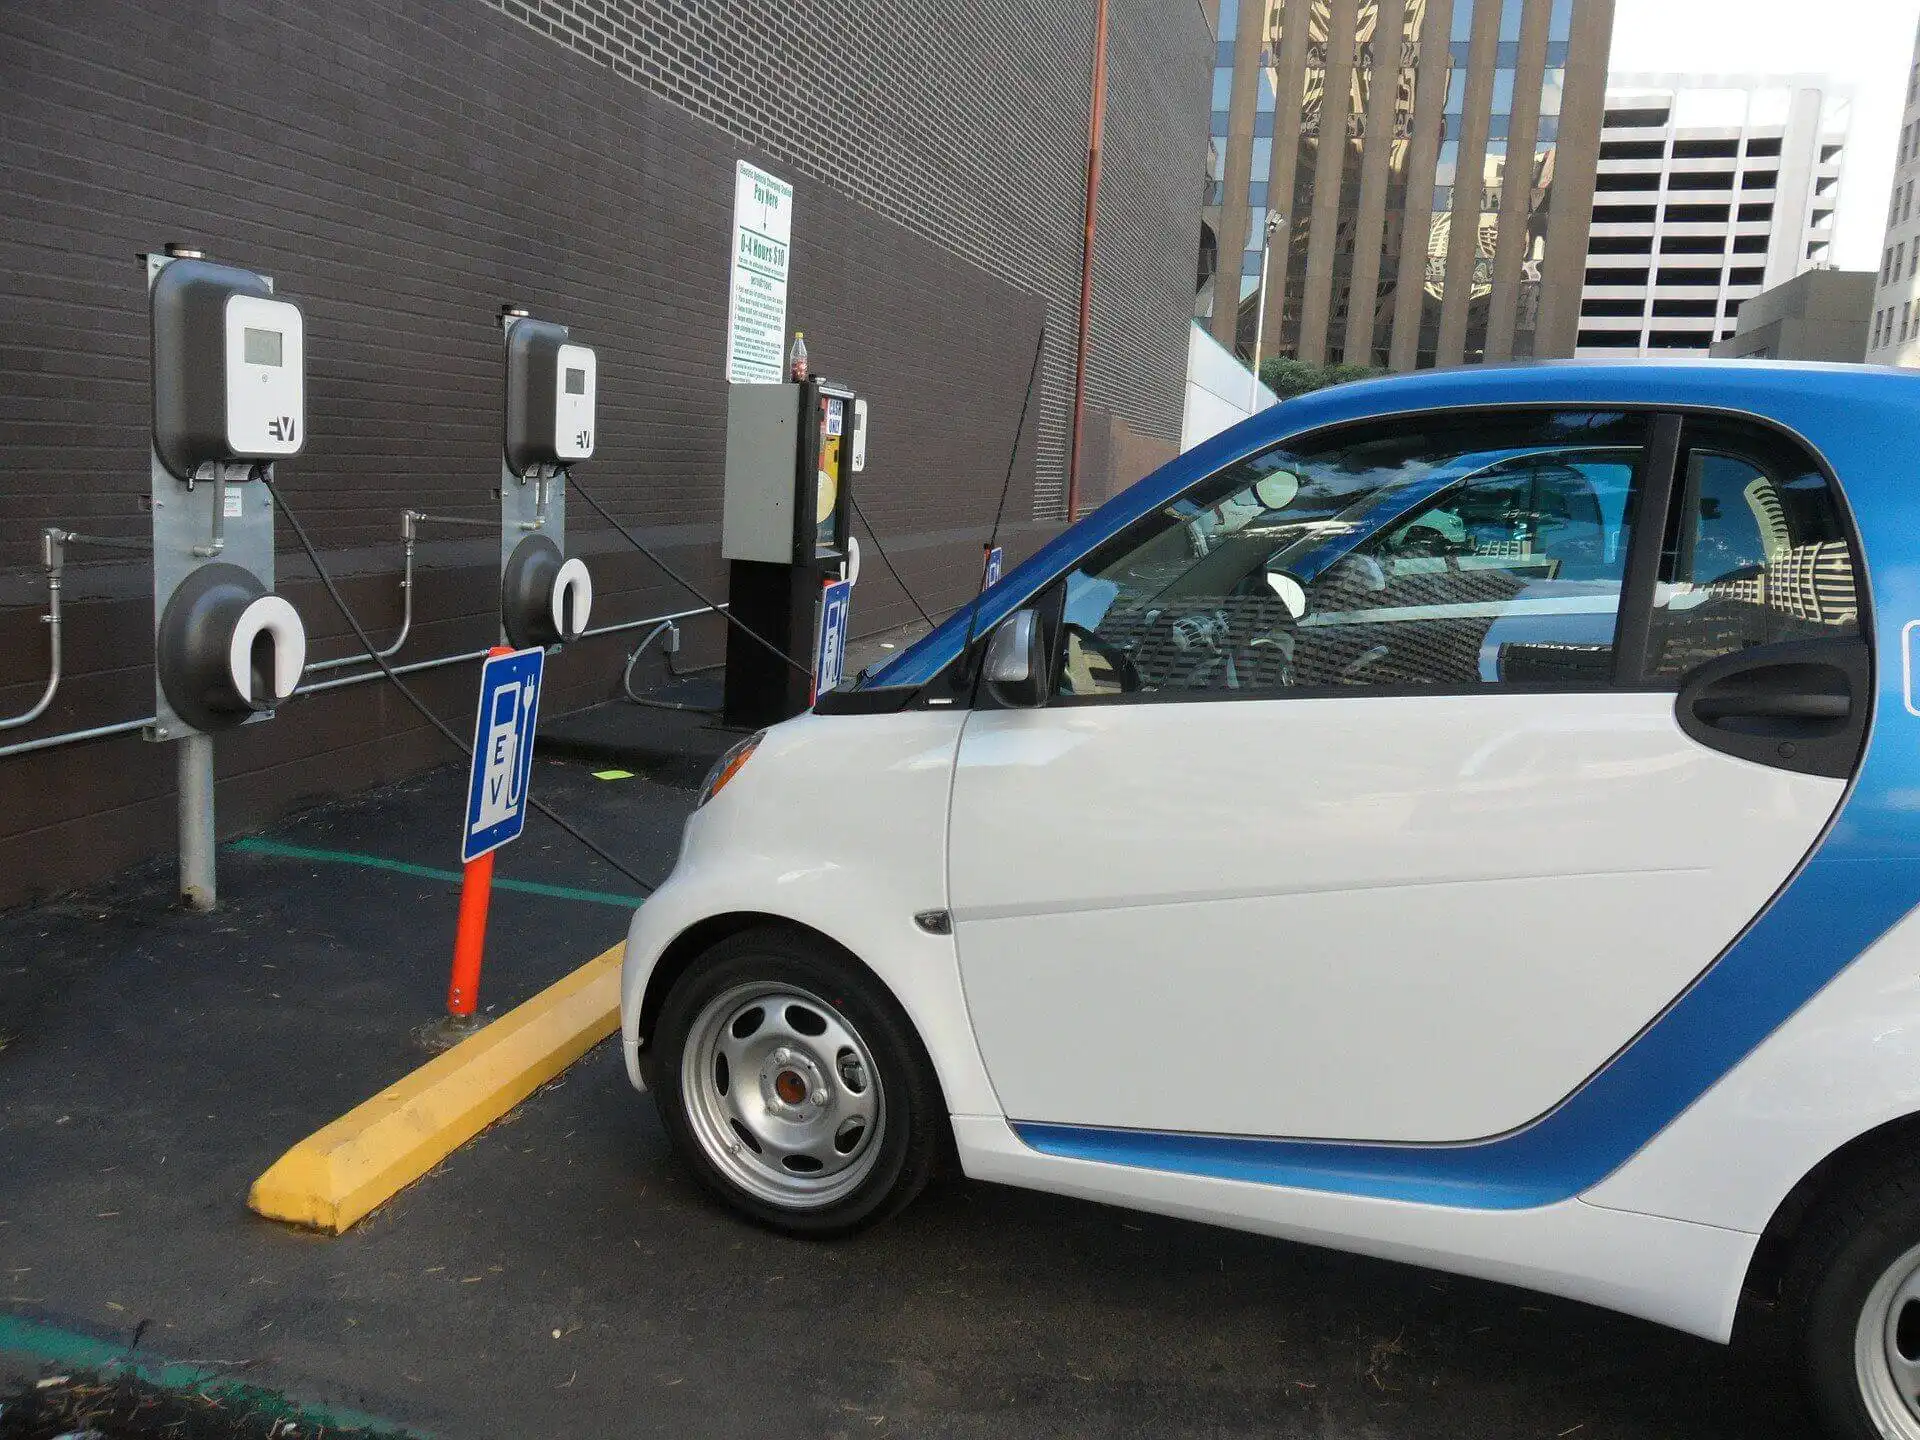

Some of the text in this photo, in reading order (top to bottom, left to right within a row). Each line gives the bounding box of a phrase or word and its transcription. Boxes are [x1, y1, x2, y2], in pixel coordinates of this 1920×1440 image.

[754, 183, 778, 209] Pay Here
[741, 233, 752, 255] 0-4
[753, 239, 772, 262] Hours
[773, 246, 785, 267] $10
[268, 416, 295, 442] EV
[576, 431, 590, 449] EV
